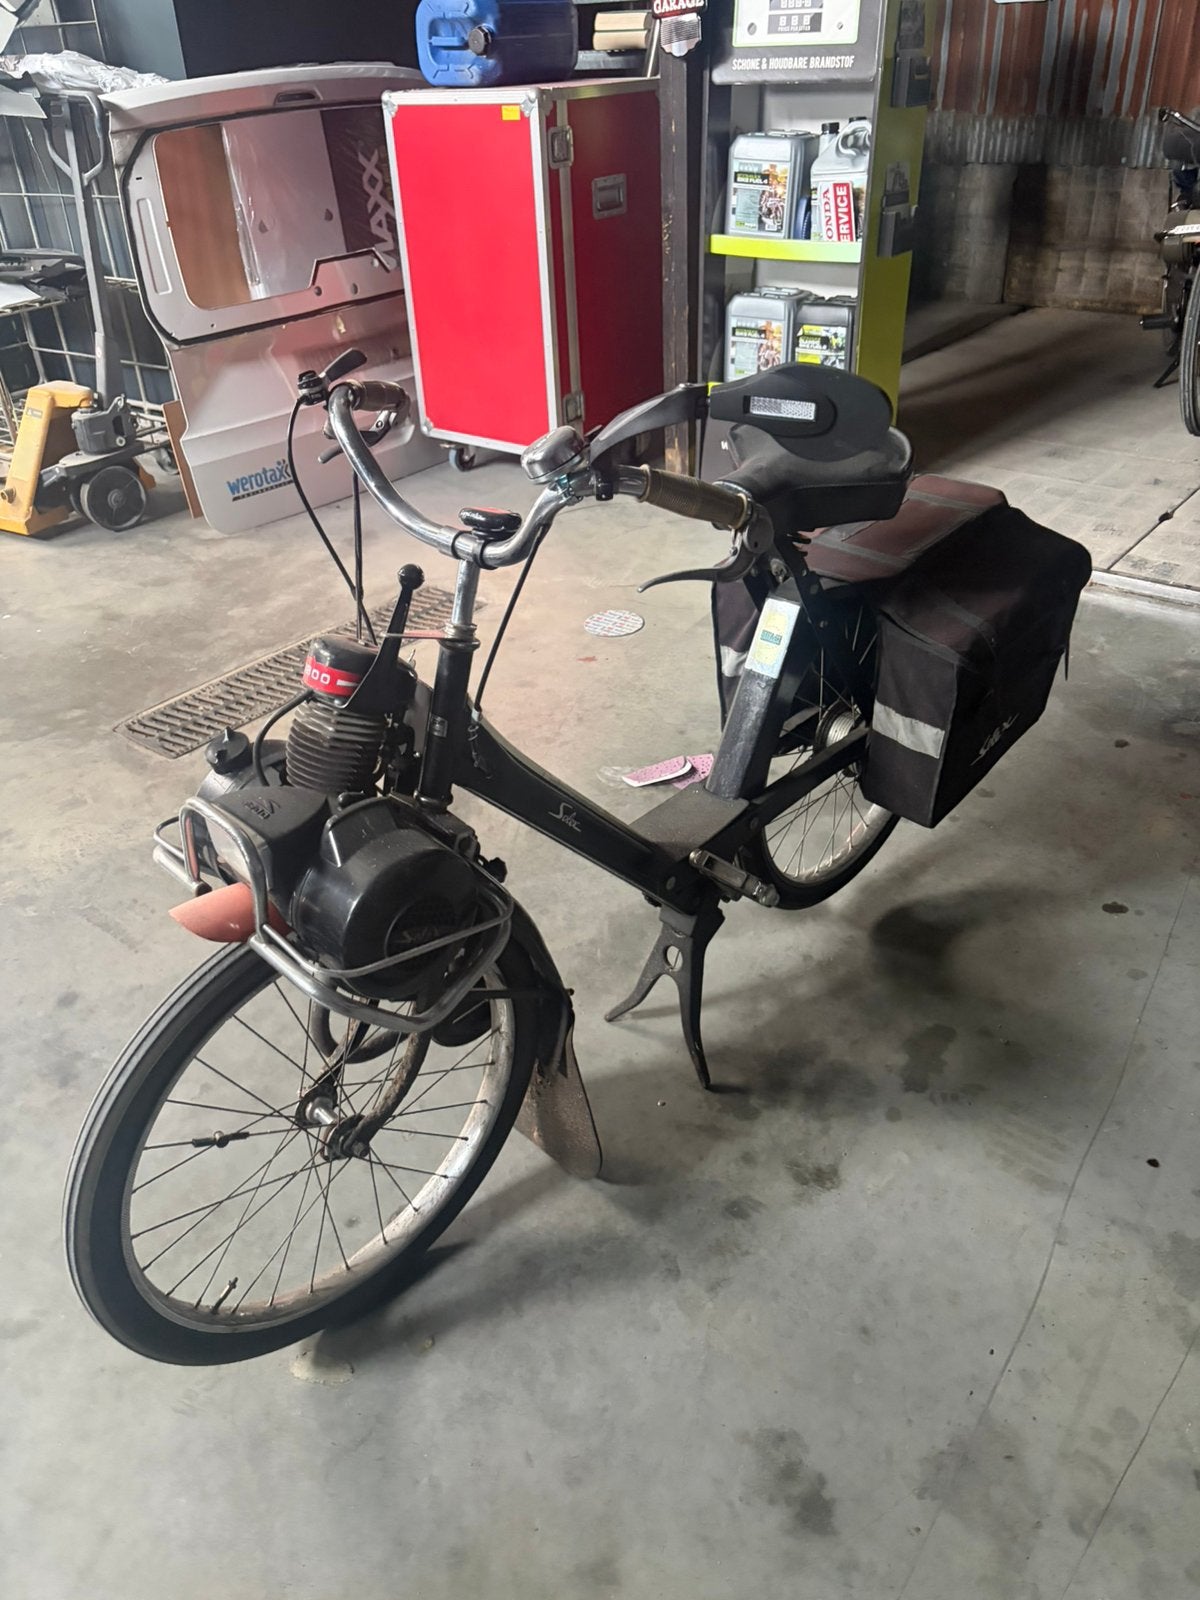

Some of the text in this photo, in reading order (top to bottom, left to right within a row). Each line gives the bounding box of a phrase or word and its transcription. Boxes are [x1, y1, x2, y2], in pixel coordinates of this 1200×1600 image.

[732, 56, 855, 71] SCHONE & HOUDBARE BRANDSTOF
[823, 188, 834, 240] ONDA
[836, 186, 852, 241] ERVICE
